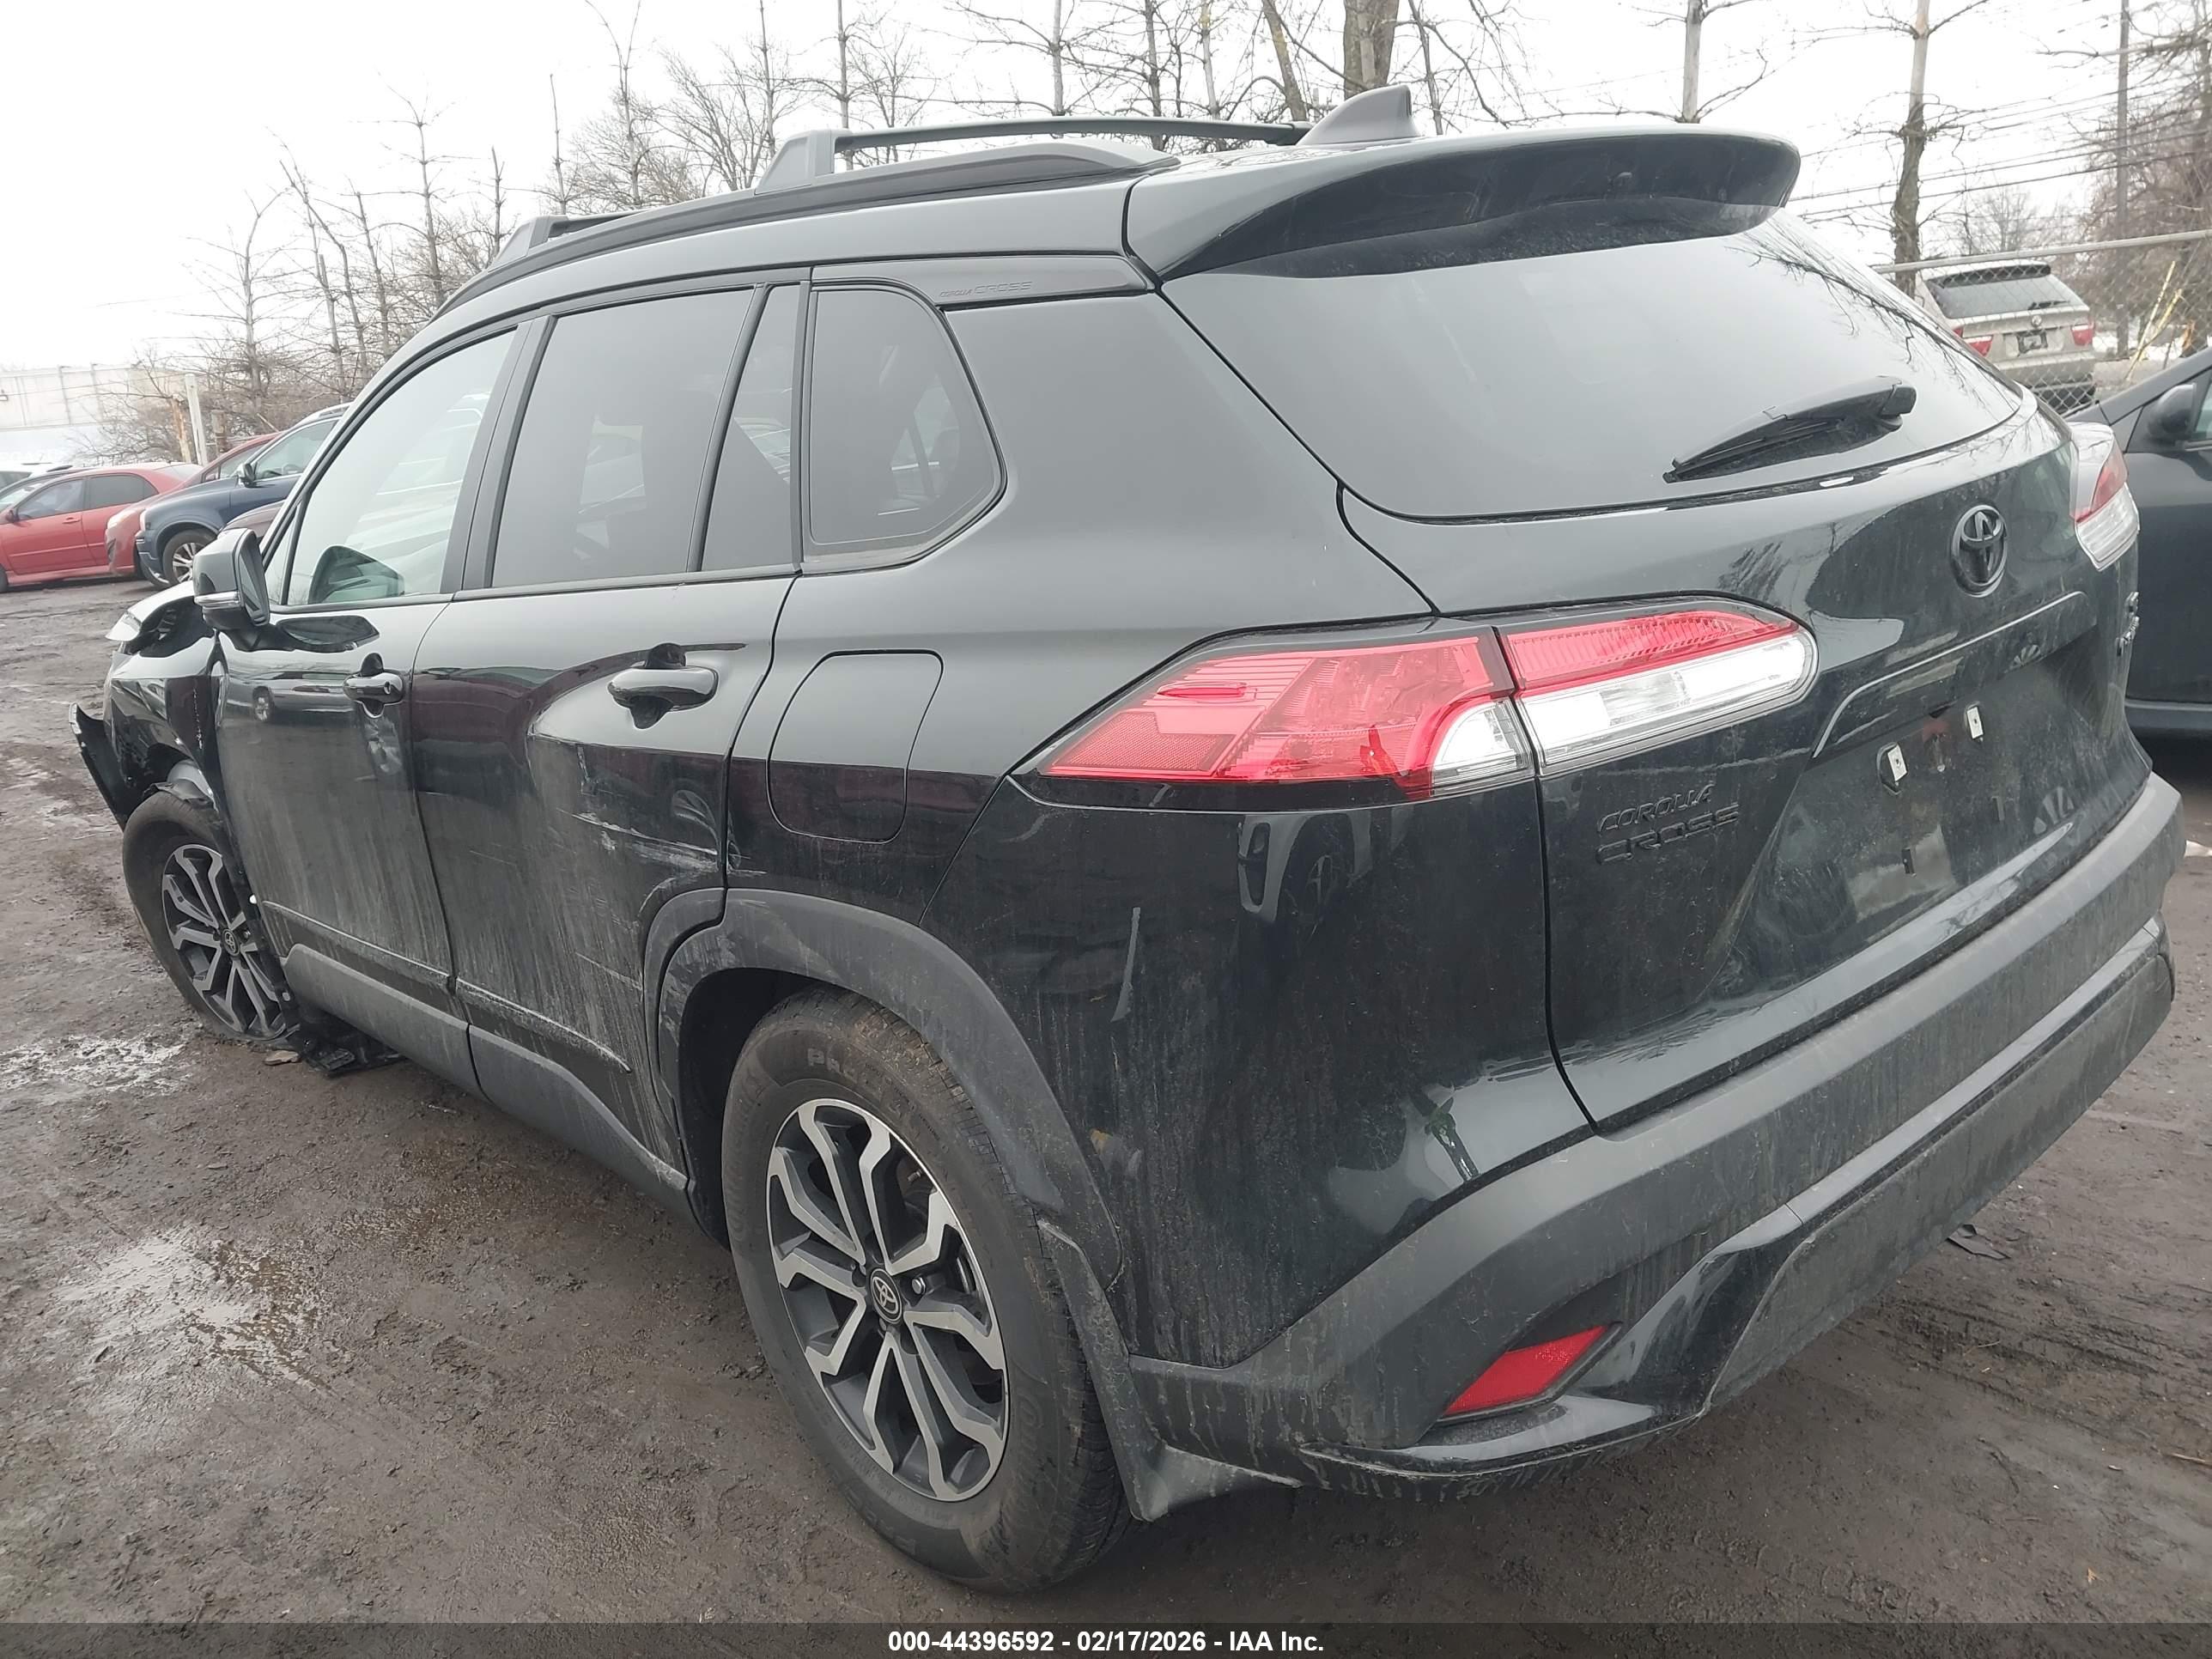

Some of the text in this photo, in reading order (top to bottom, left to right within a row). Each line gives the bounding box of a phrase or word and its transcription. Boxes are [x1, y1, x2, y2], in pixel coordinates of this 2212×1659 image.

[975, 281, 1033, 295] CROSS
[1596, 802, 1740, 864] CROSS
[1597, 782, 1716, 833] COROLLA
